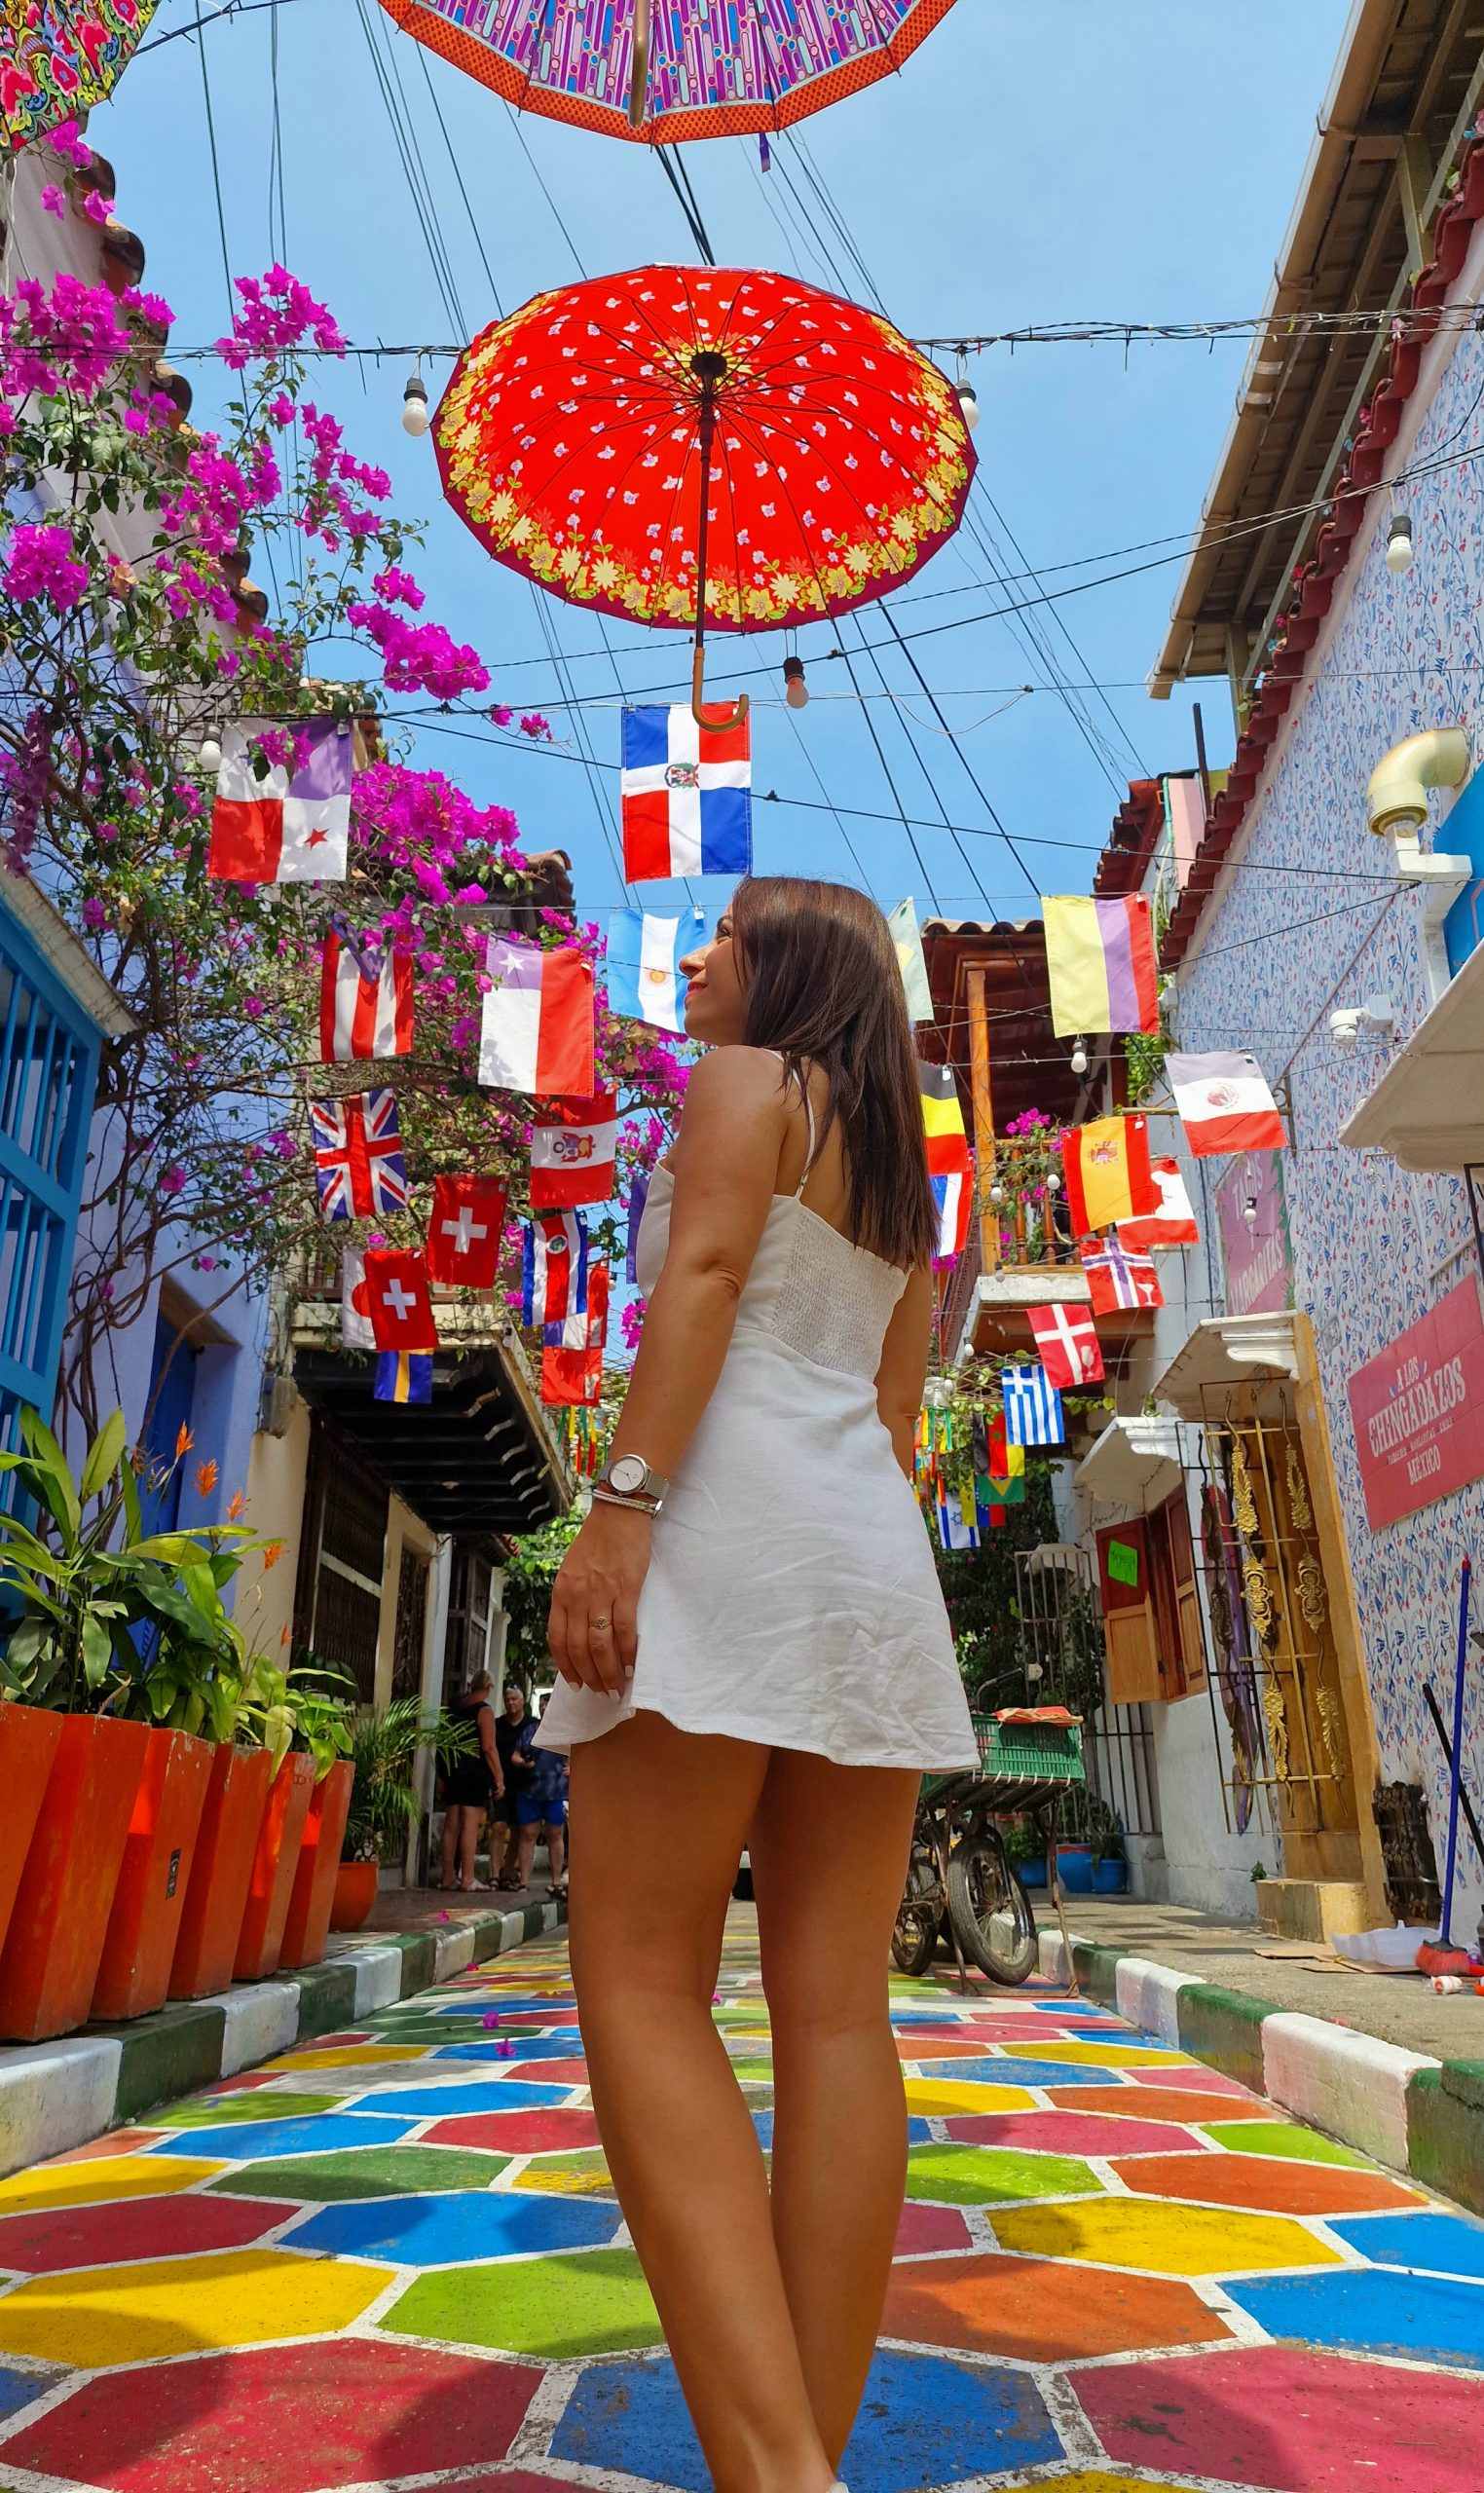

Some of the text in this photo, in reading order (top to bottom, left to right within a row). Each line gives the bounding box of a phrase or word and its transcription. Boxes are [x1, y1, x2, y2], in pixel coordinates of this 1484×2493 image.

[1368, 1356, 1465, 1458] CHINGADAZOS
[1396, 1356, 1420, 1393] A LOS
